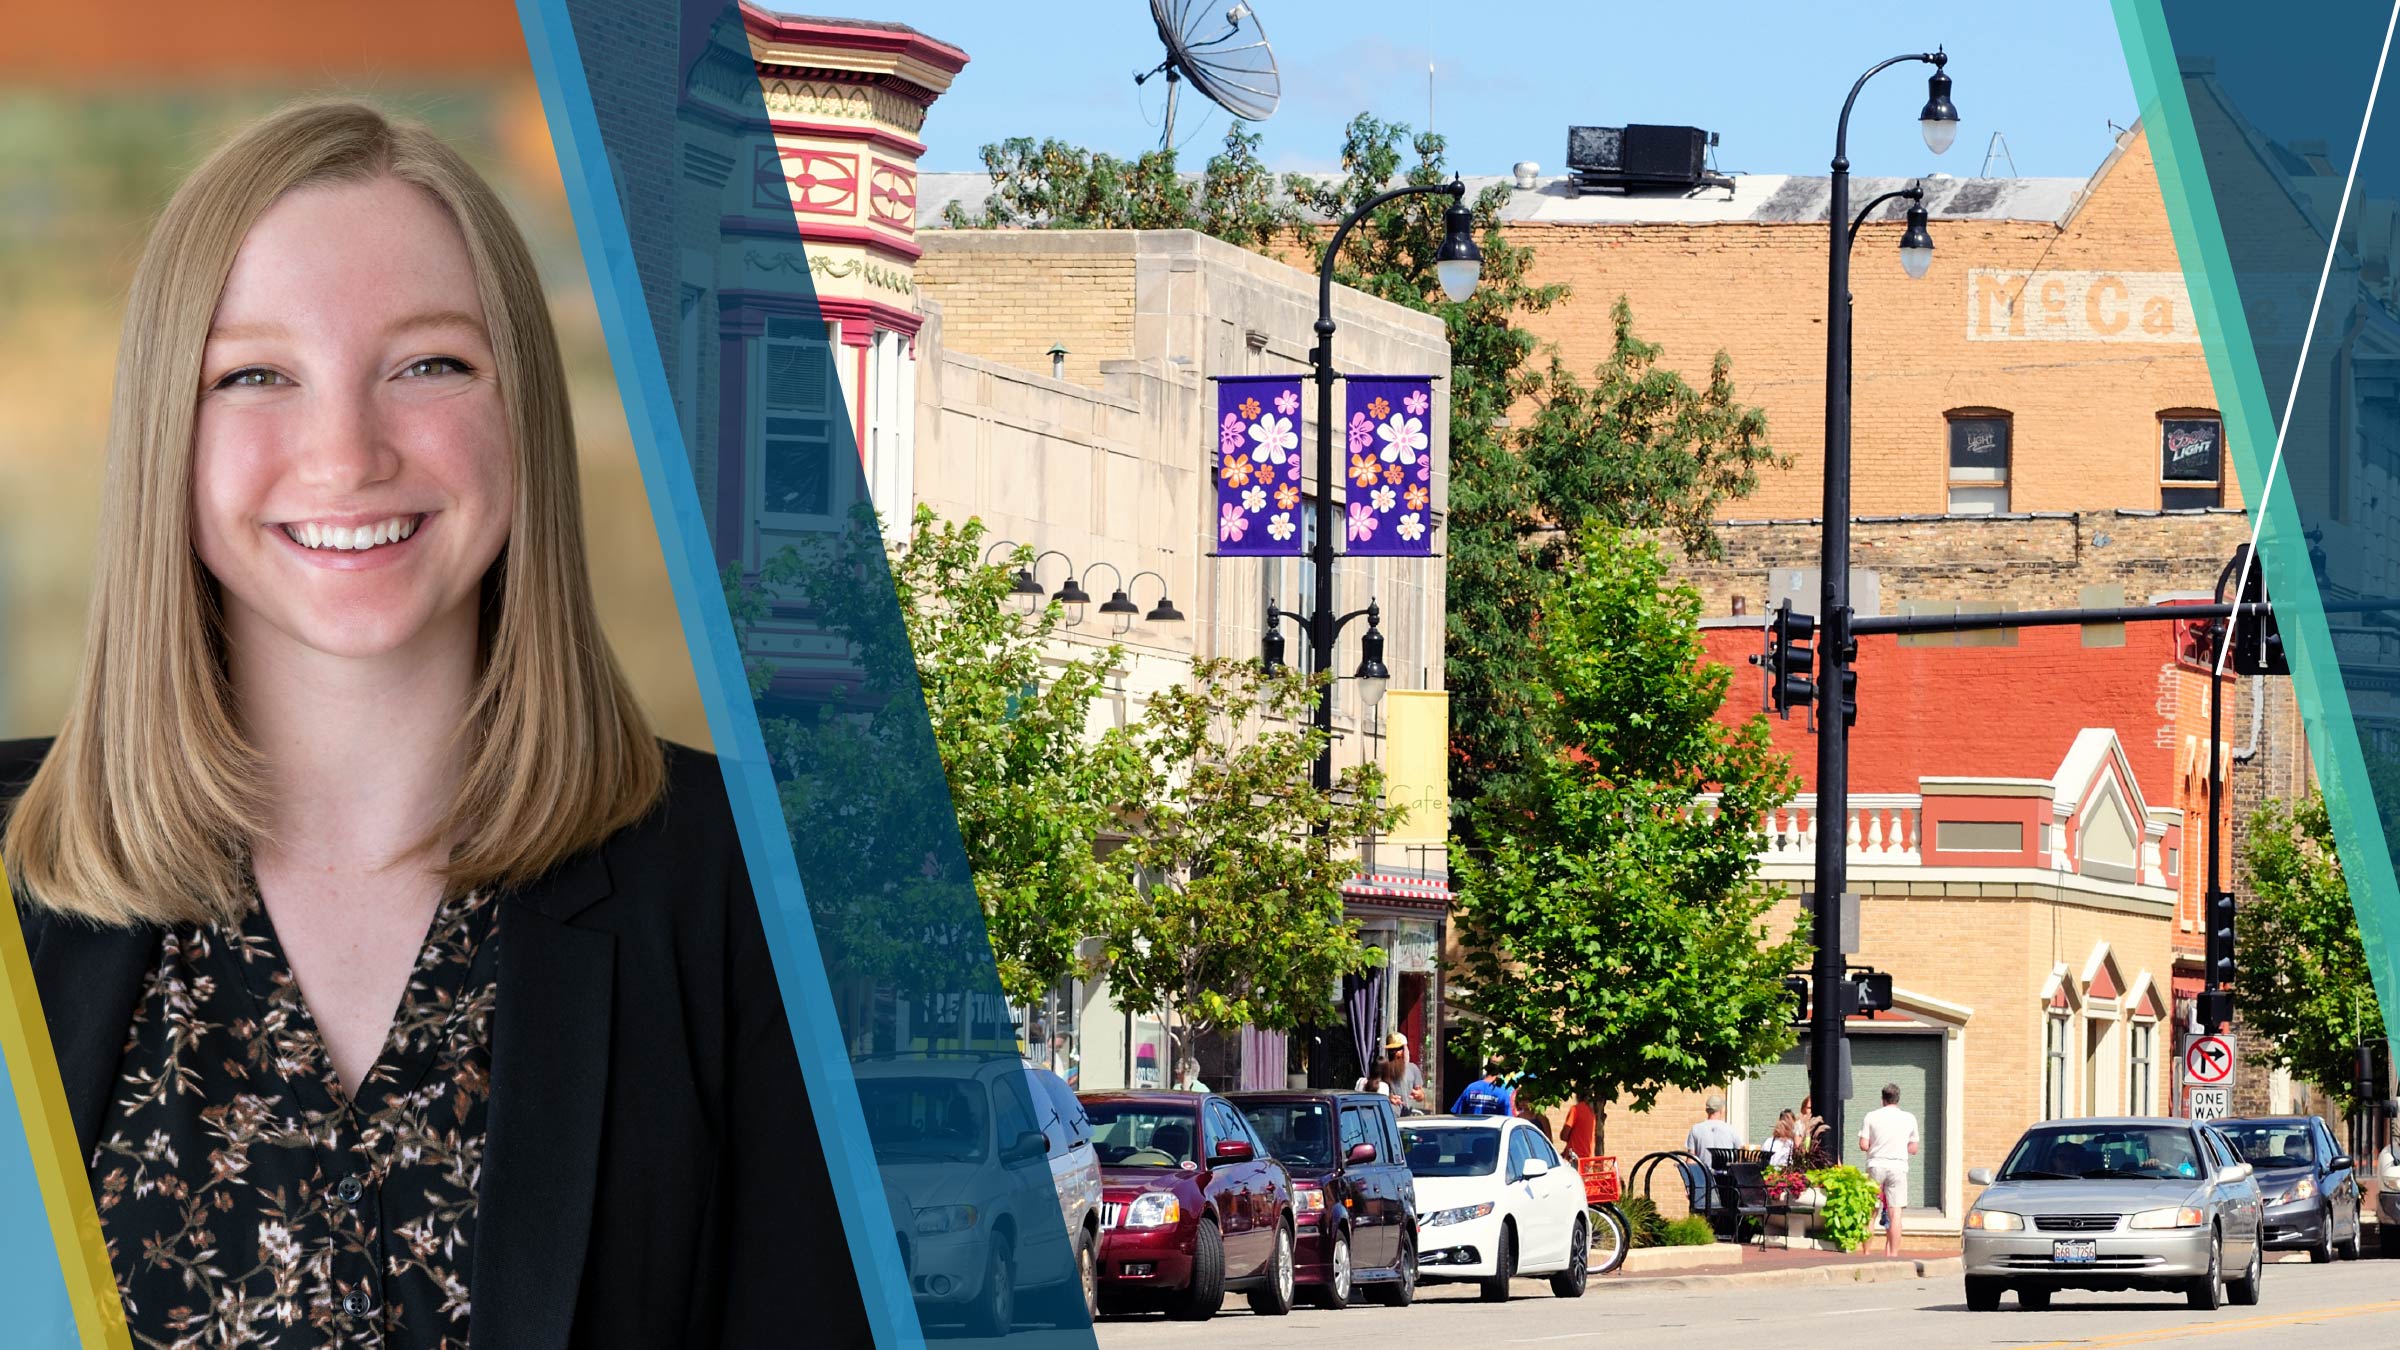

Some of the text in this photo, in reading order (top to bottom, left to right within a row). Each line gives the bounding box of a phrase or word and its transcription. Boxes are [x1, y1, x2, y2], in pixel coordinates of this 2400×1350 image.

[1967, 433, 1995, 445] LIGHT
[2172, 440, 2212, 462] LIGHT
[1389, 785, 1442, 814] Cafe
[2195, 1093, 2224, 1105] ONE
[2194, 1107, 2224, 1119] WAY
